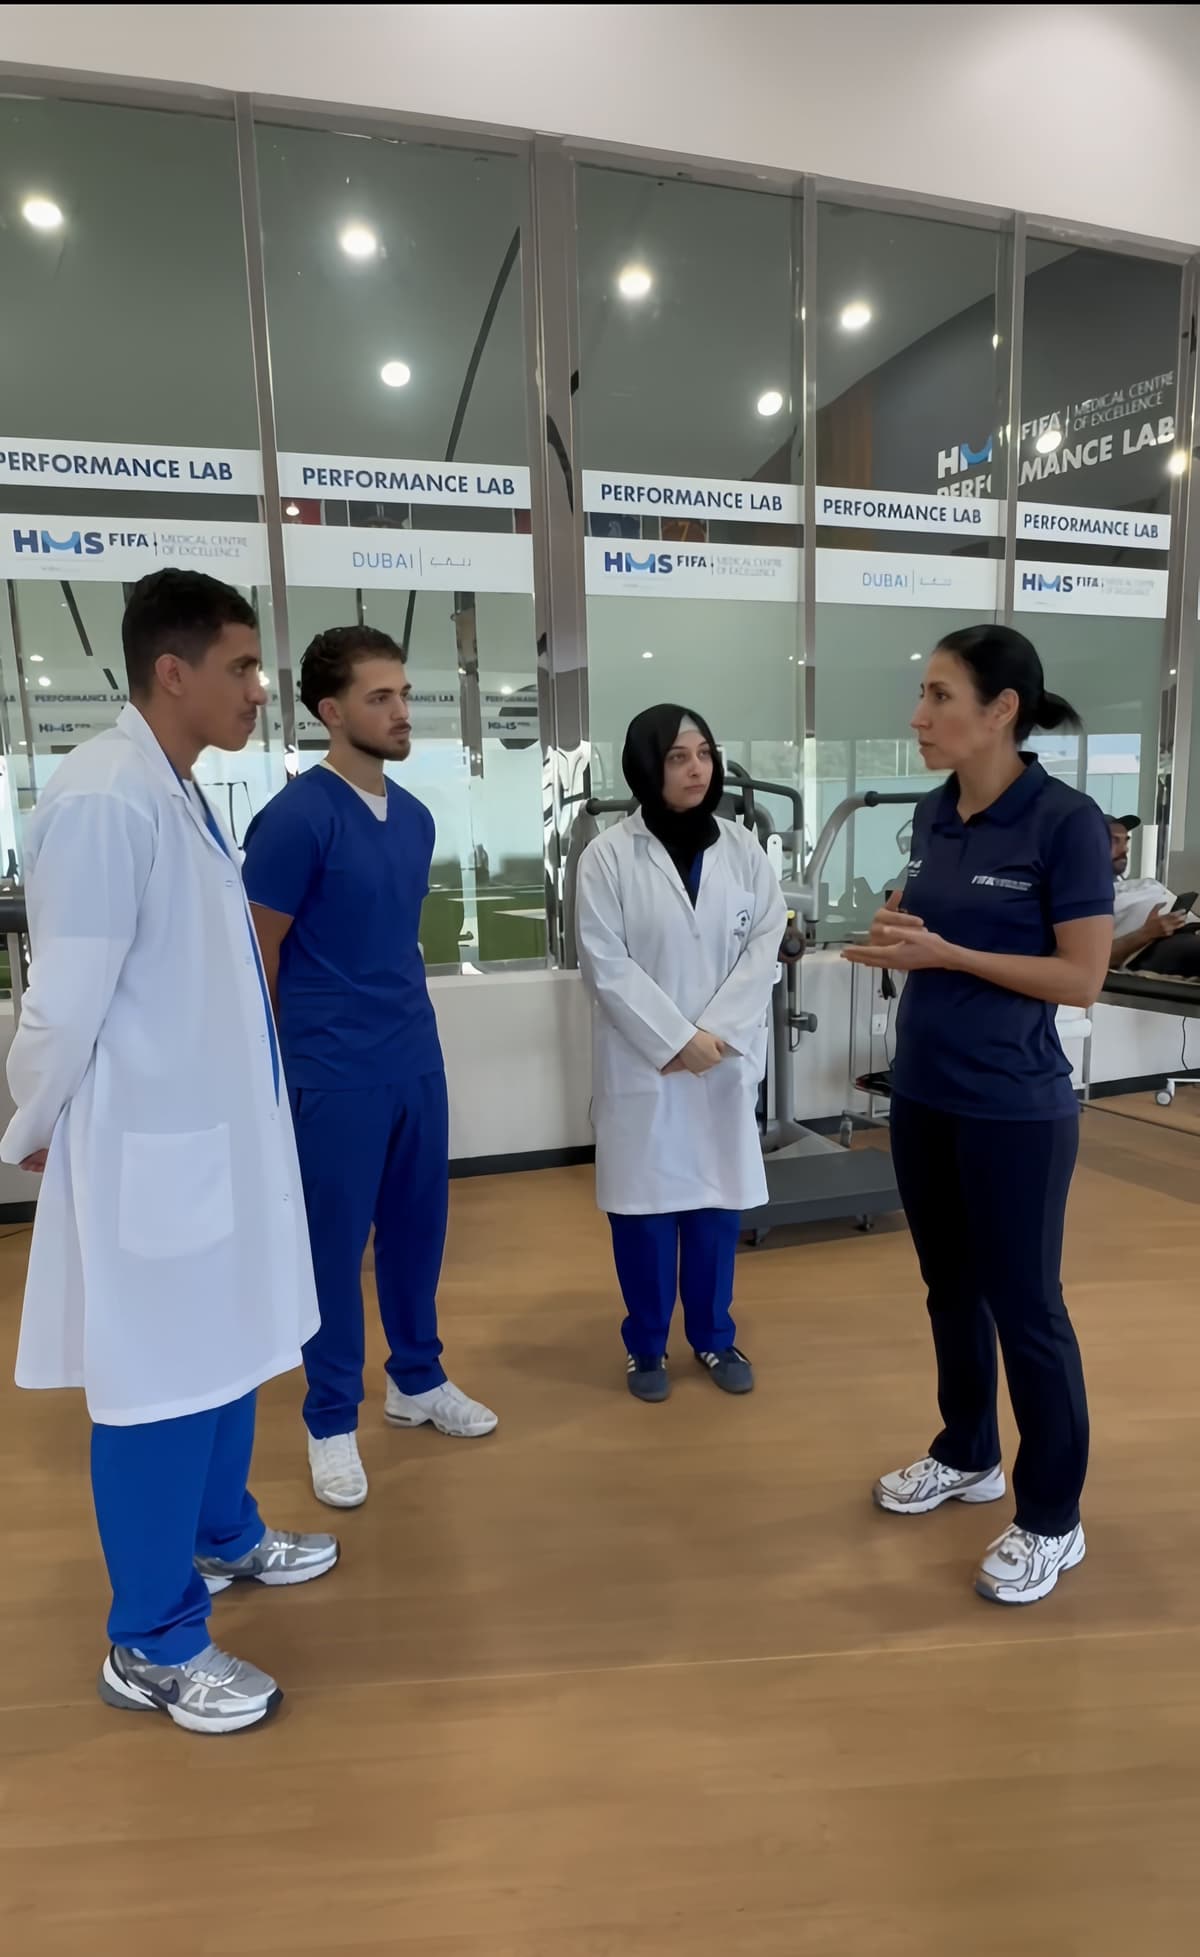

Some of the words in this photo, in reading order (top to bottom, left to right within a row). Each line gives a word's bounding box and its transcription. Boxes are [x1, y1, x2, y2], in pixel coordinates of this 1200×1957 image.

[1073, 389, 1124, 417] MEDICAL
[1128, 370, 1174, 398] CENTRE
[1073, 416, 1089, 432] OF
[1090, 391, 1163, 427] EXCELLENCE
[1122, 416, 1176, 456] LAB
[189, 461, 233, 481] LAB
[302, 466, 468, 493] PERFORMANCE
[476, 477, 515, 496] LAB
[601, 484, 743, 509] PERFORMANCE
[750, 494, 783, 511] LAB
[823, 498, 947, 522] PERFORMANCE
[953, 508, 982, 524] LAB
[1023, 513, 1130, 536] PERFORMANCE
[1134, 525, 1159, 539] LAB
[13, 529, 105, 555] HMS
[109, 533, 149, 548] FIFA
[352, 551, 413, 569] DUBAI
[604, 551, 673, 574] HMS
[677, 555, 707, 568] FIFA
[862, 572, 908, 588] DUBAI
[1022, 573, 1074, 593] HMS
[1076, 576, 1099, 588] FIFA
